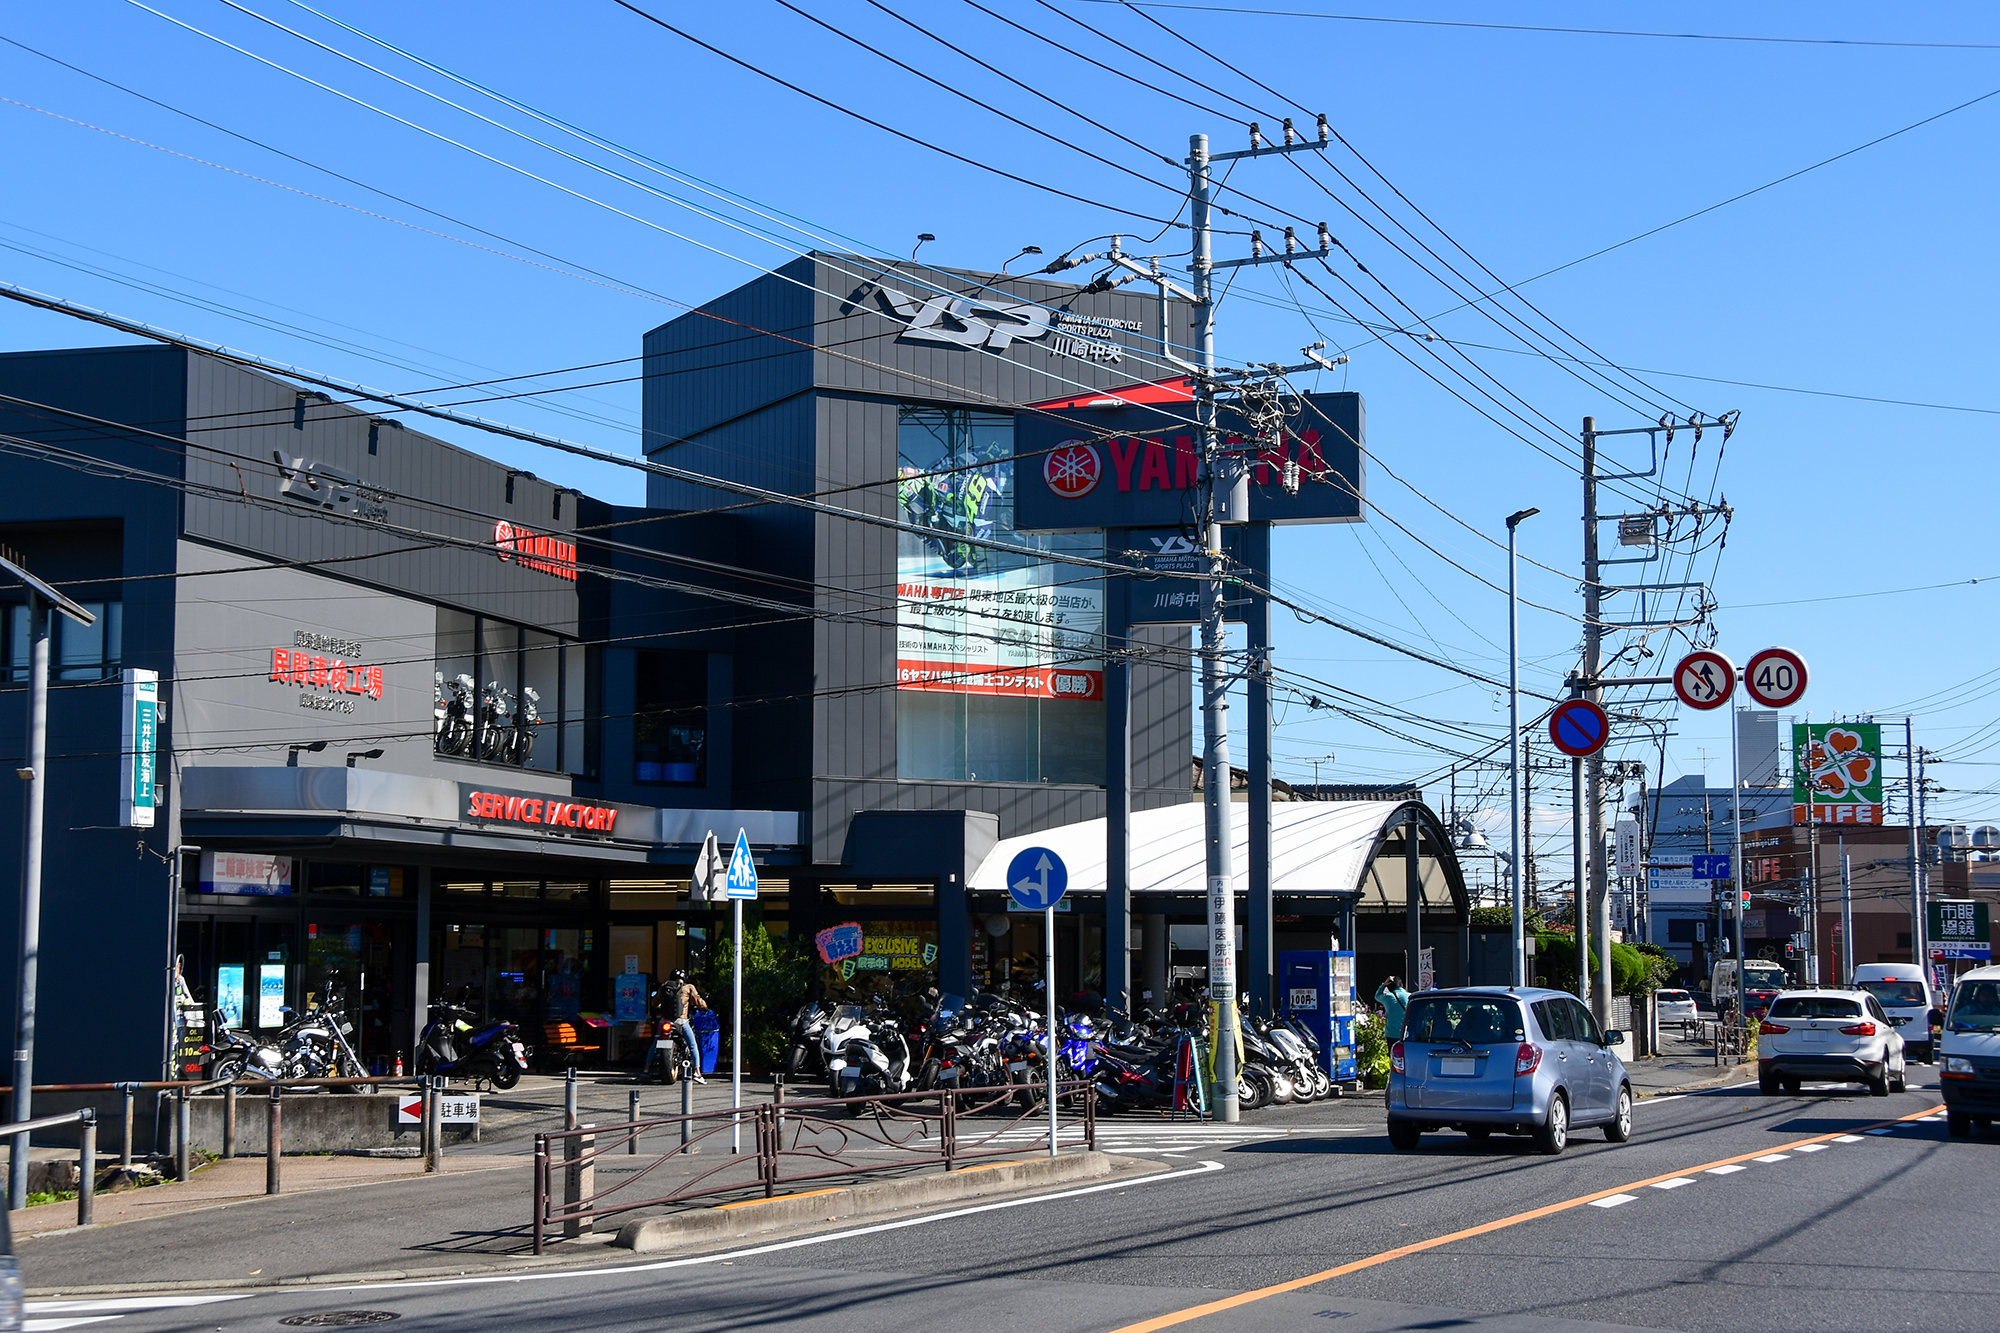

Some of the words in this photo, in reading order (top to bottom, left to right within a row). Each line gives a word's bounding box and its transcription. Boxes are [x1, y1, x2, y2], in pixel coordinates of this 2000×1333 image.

[874, 289, 1051, 350] YSP
[1057, 323, 1088, 335] SPORTS
[1087, 326, 1113, 338] PLAZA
[1058, 312, 1091, 325] YAMAHA
[1091, 316, 1143, 332] MOTORCYCLE
[1053, 337, 1122, 362] 川崎中央
[514, 526, 577, 581] YAMAHA
[1150, 535, 1200, 554] YS
[969, 588, 1097, 610] 関東地区最大級の当店が、
[910, 603, 1071, 625] 最上級のサビスを約束します。
[272, 648, 383, 699] 民間車検工場
[1056, 673, 1087, 694] 優勝
[1756, 665, 1793, 691] 40
[140, 708, 152, 798] 三井住友海上
[469, 791, 544, 824] SERVICE
[545, 800, 618, 832] FACTORY
[1805, 805, 1873, 823] LIFE
[216, 857, 290, 881] 二輪車検査ライン
[1751, 857, 1780, 882] LIFE
[1214, 896, 1227, 956] 伊藤医院
[864, 936, 918, 955] EXCLUSIVE
[891, 956, 922, 969] MODEL
[441, 1102, 478, 1119] 駐車場
